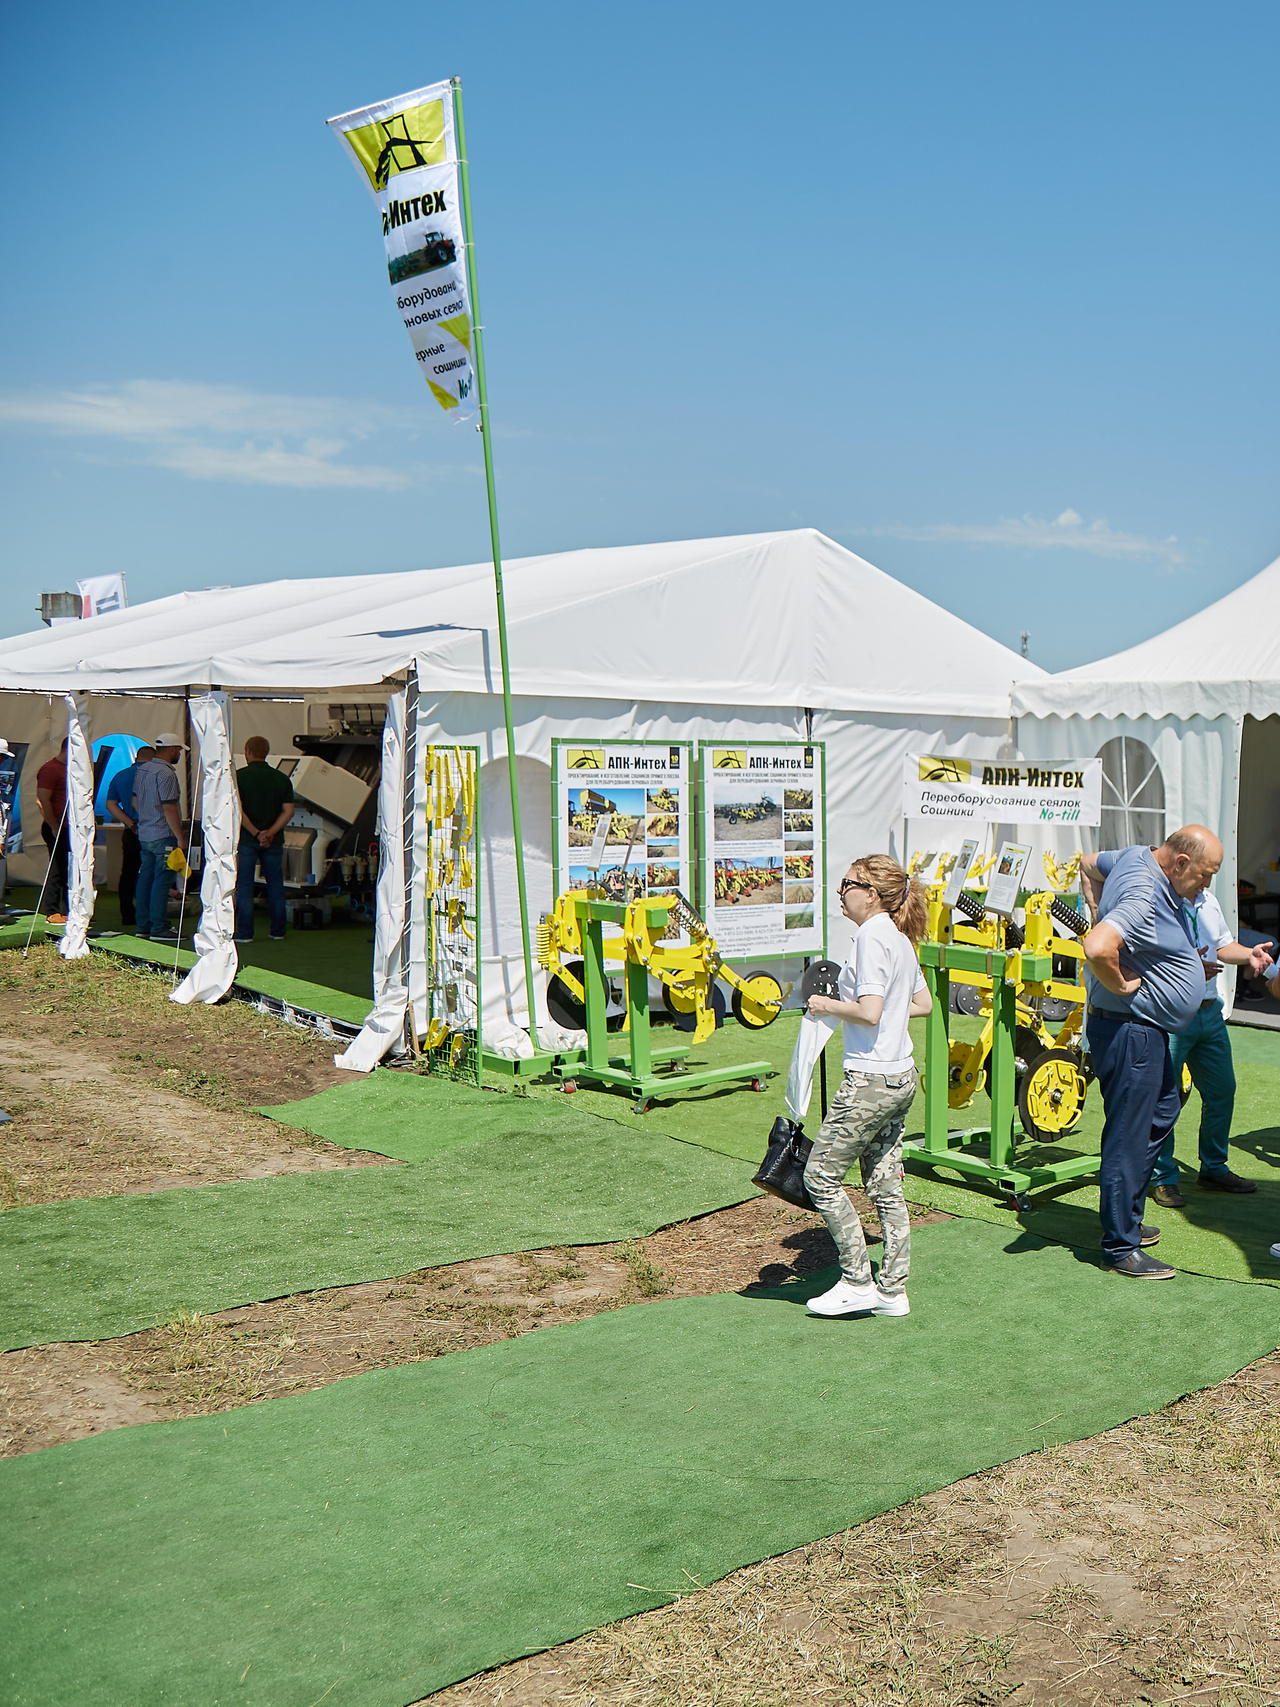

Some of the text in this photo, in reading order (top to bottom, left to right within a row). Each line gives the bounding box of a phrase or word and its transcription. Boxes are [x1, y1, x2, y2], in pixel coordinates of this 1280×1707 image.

[608, 756, 667, 770] АПК-Интех
[749, 757, 802, 769] АПК-Интех
[981, 766, 1084, 788] АПК-Интех
[921, 791, 1081, 808] Переоборудование сеялок
[920, 804, 974, 817] Сошники
[1039, 808, 1081, 821] No-till
